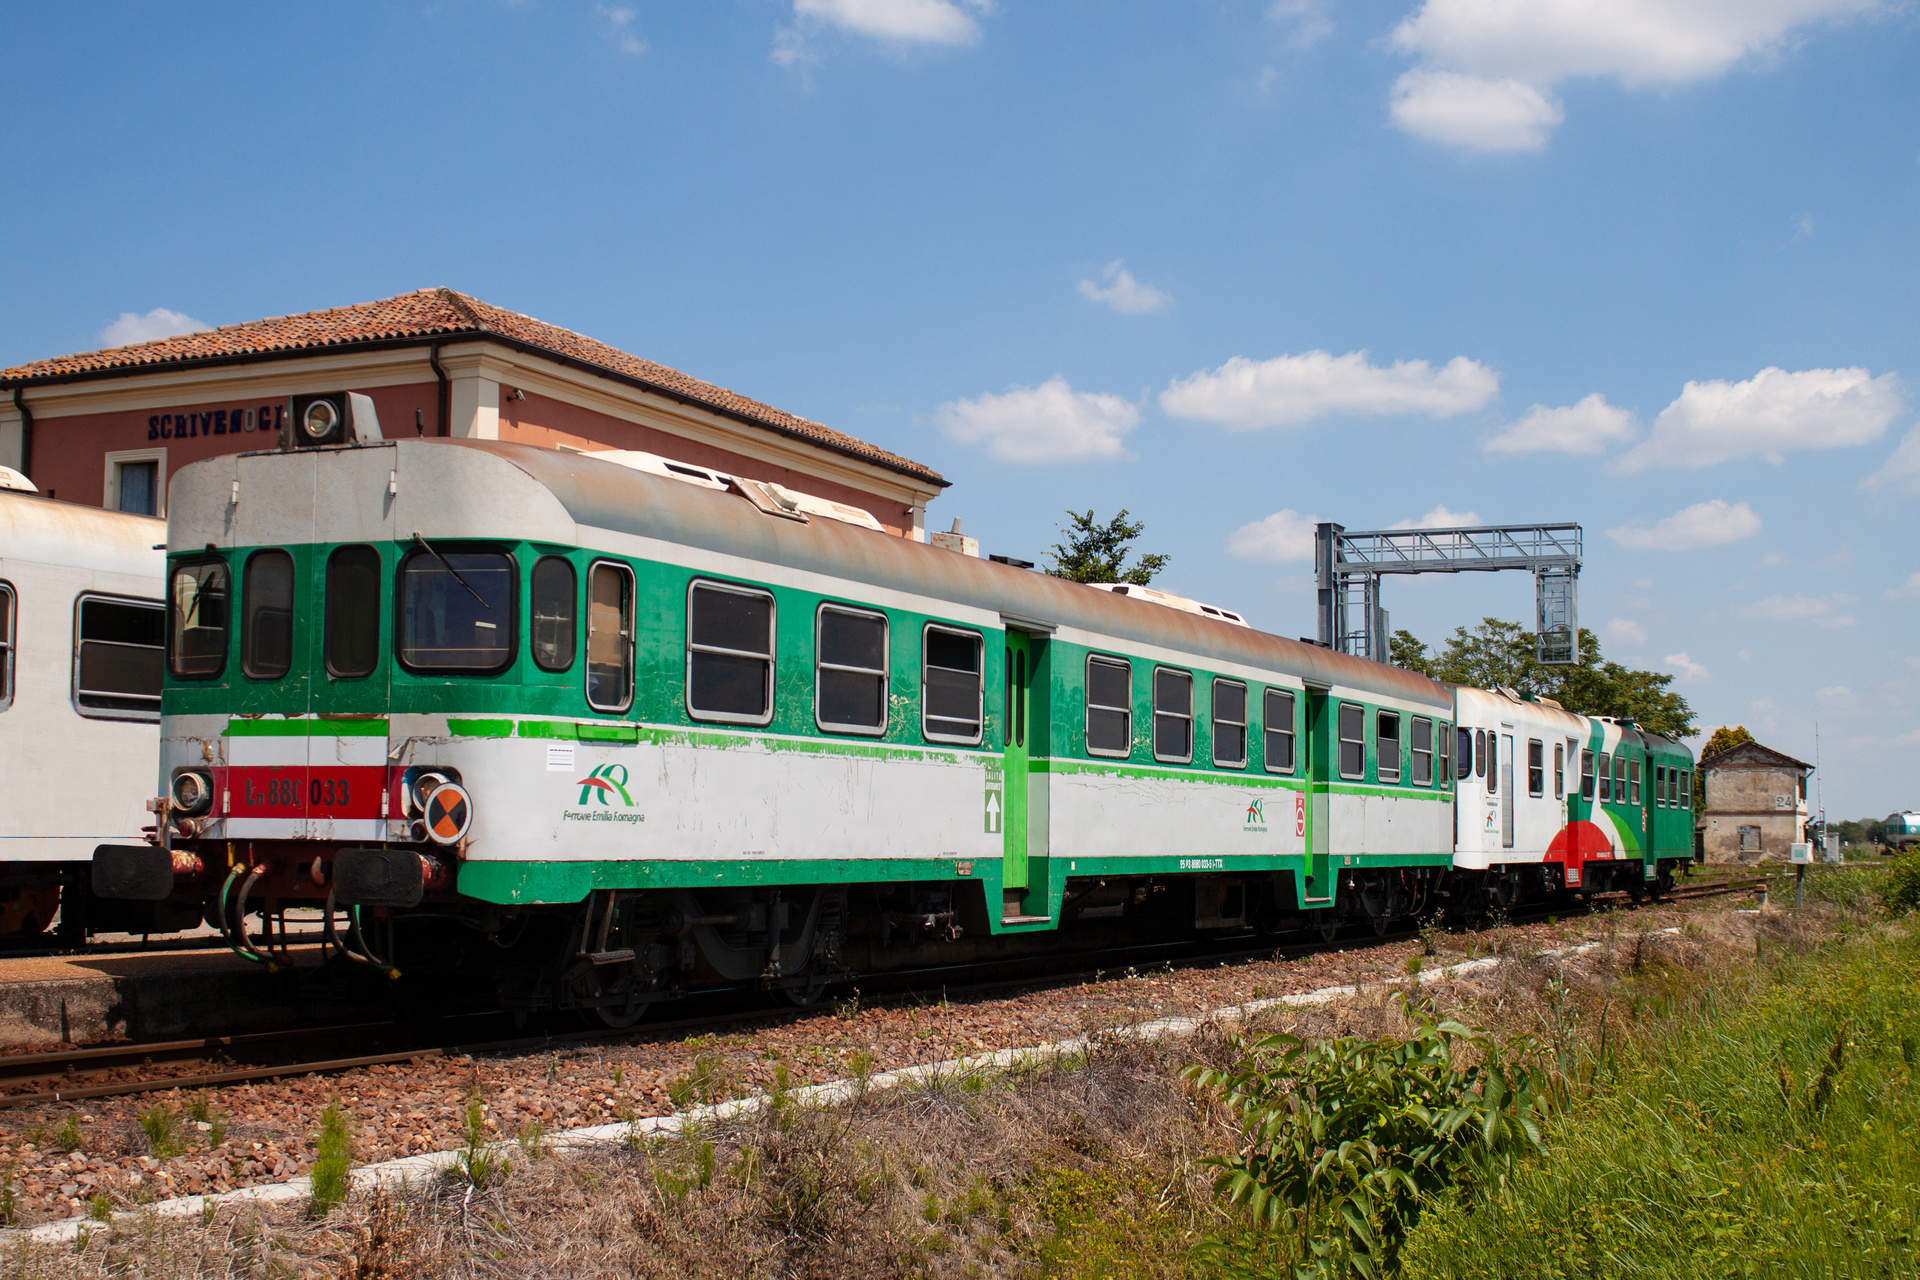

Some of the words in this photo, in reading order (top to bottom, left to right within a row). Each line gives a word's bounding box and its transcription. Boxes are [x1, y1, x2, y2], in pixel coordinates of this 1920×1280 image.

[310, 778, 350, 806] 033
[1776, 796, 1792, 807] 24
[563, 810, 592, 821] Ferrovie
[592, 810, 613, 821] Emilia
[613, 811, 645, 825] Romagna
